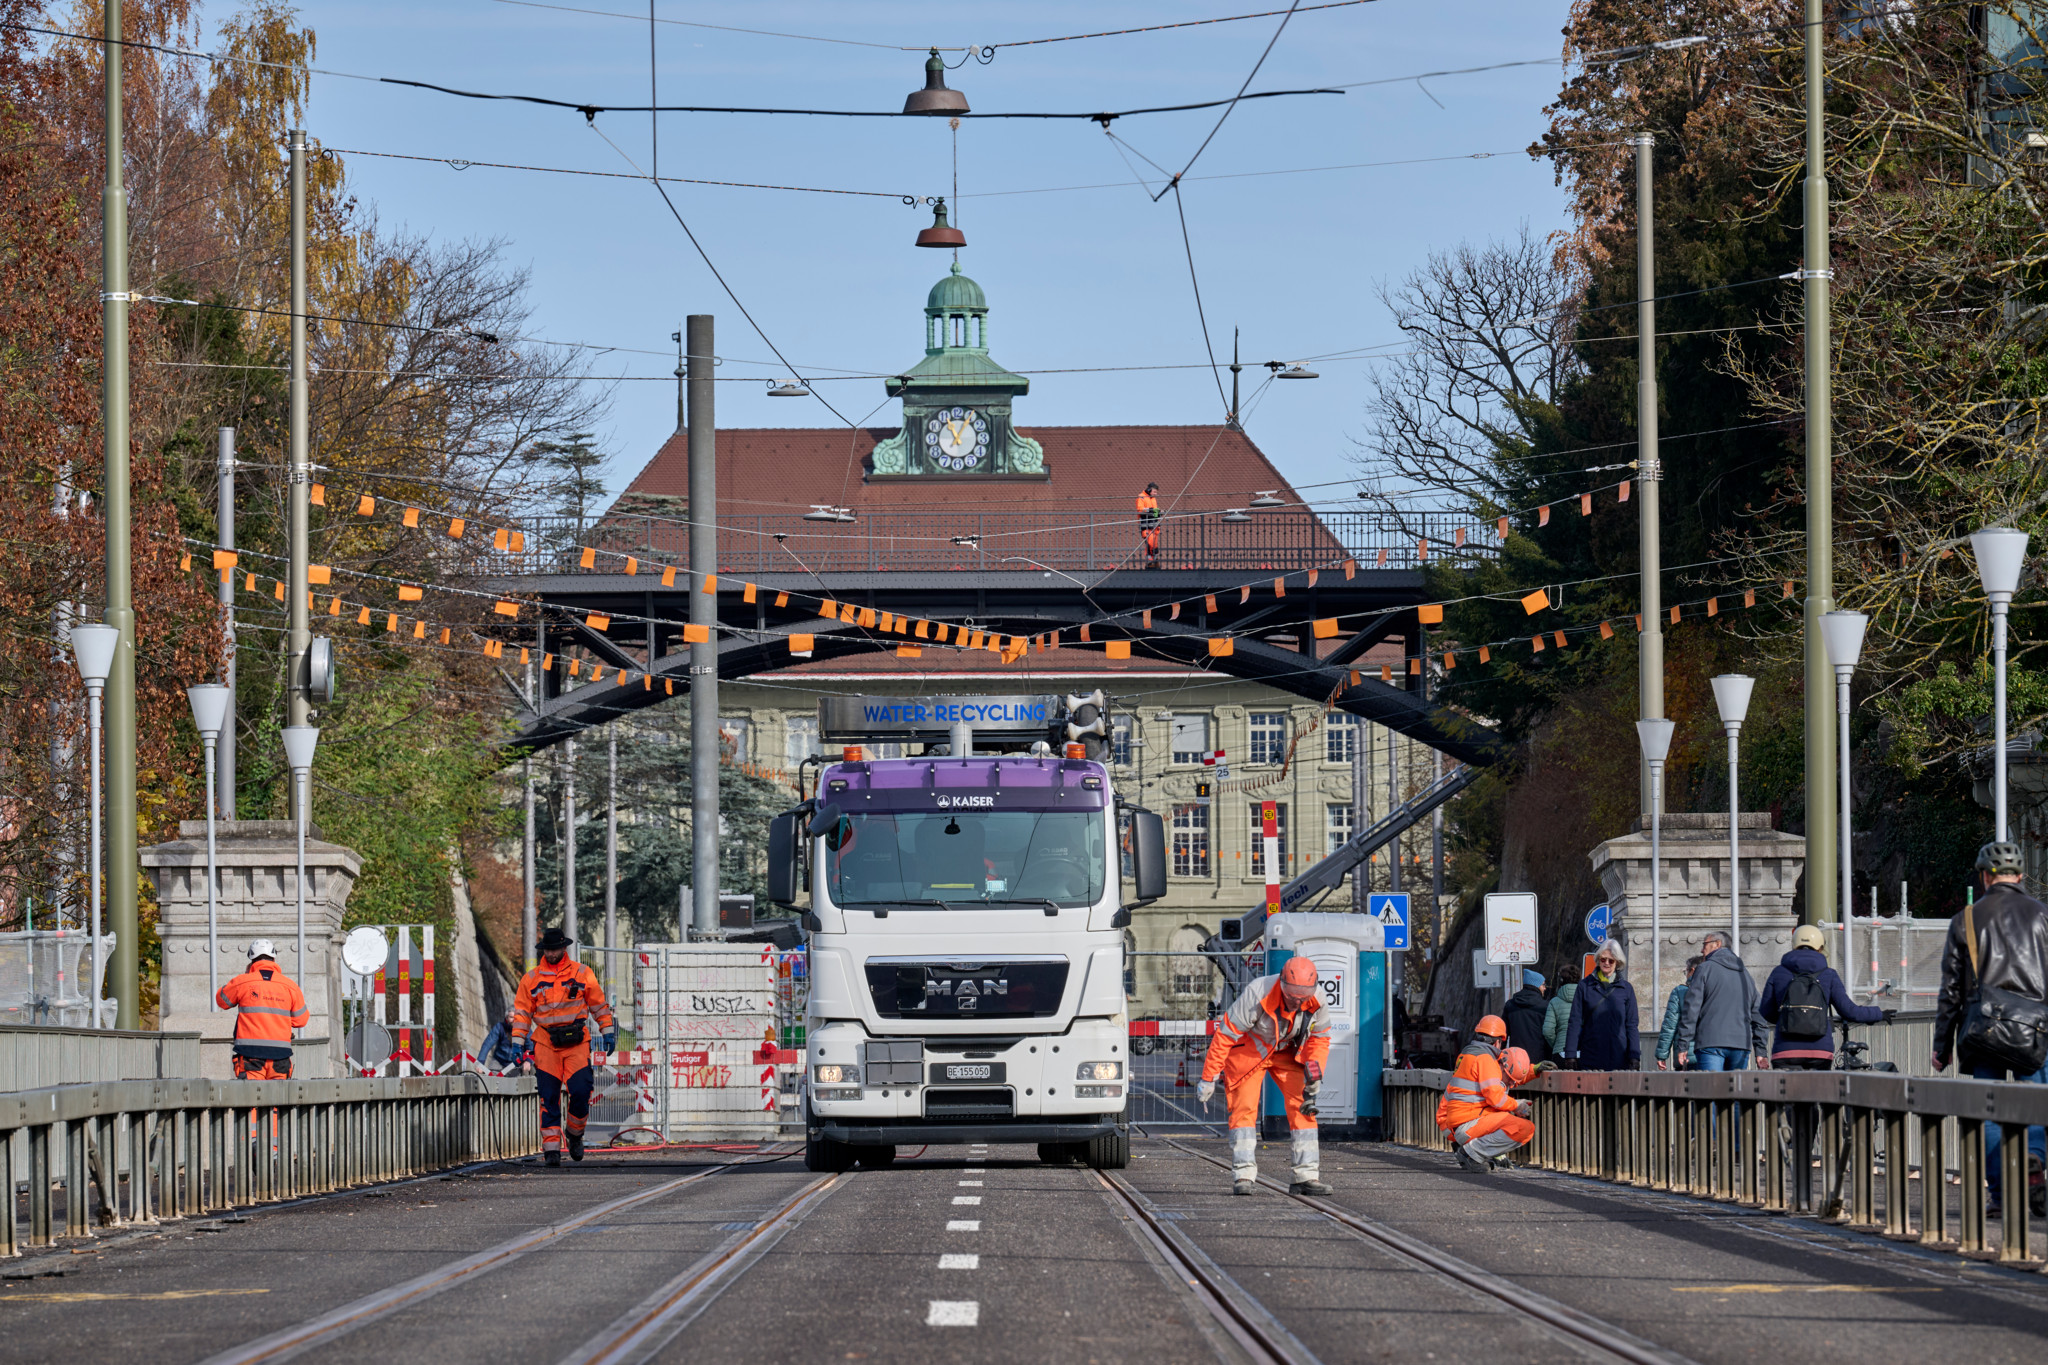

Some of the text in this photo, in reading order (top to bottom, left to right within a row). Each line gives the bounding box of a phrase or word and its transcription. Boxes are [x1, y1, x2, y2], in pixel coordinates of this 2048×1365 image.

[940, 412, 949, 422] 11
[953, 408, 962, 418] 12
[930, 421, 940, 431] 10
[976, 420, 984, 430] 2
[928, 434, 936, 444] 9
[980, 433, 987, 443] 3
[932, 447, 939, 457] 8
[976, 446, 984, 456] 4
[942, 456, 949, 466] 7
[954, 459, 962, 470] 6
[966, 456, 974, 466] 5
[864, 704, 1046, 722] WATER-RECYCLING
[1217, 768, 1230, 778] 25
[952, 796, 994, 806] KAISER
[926, 979, 1008, 996] MAN
[672, 1054, 702, 1064] Frutiger
